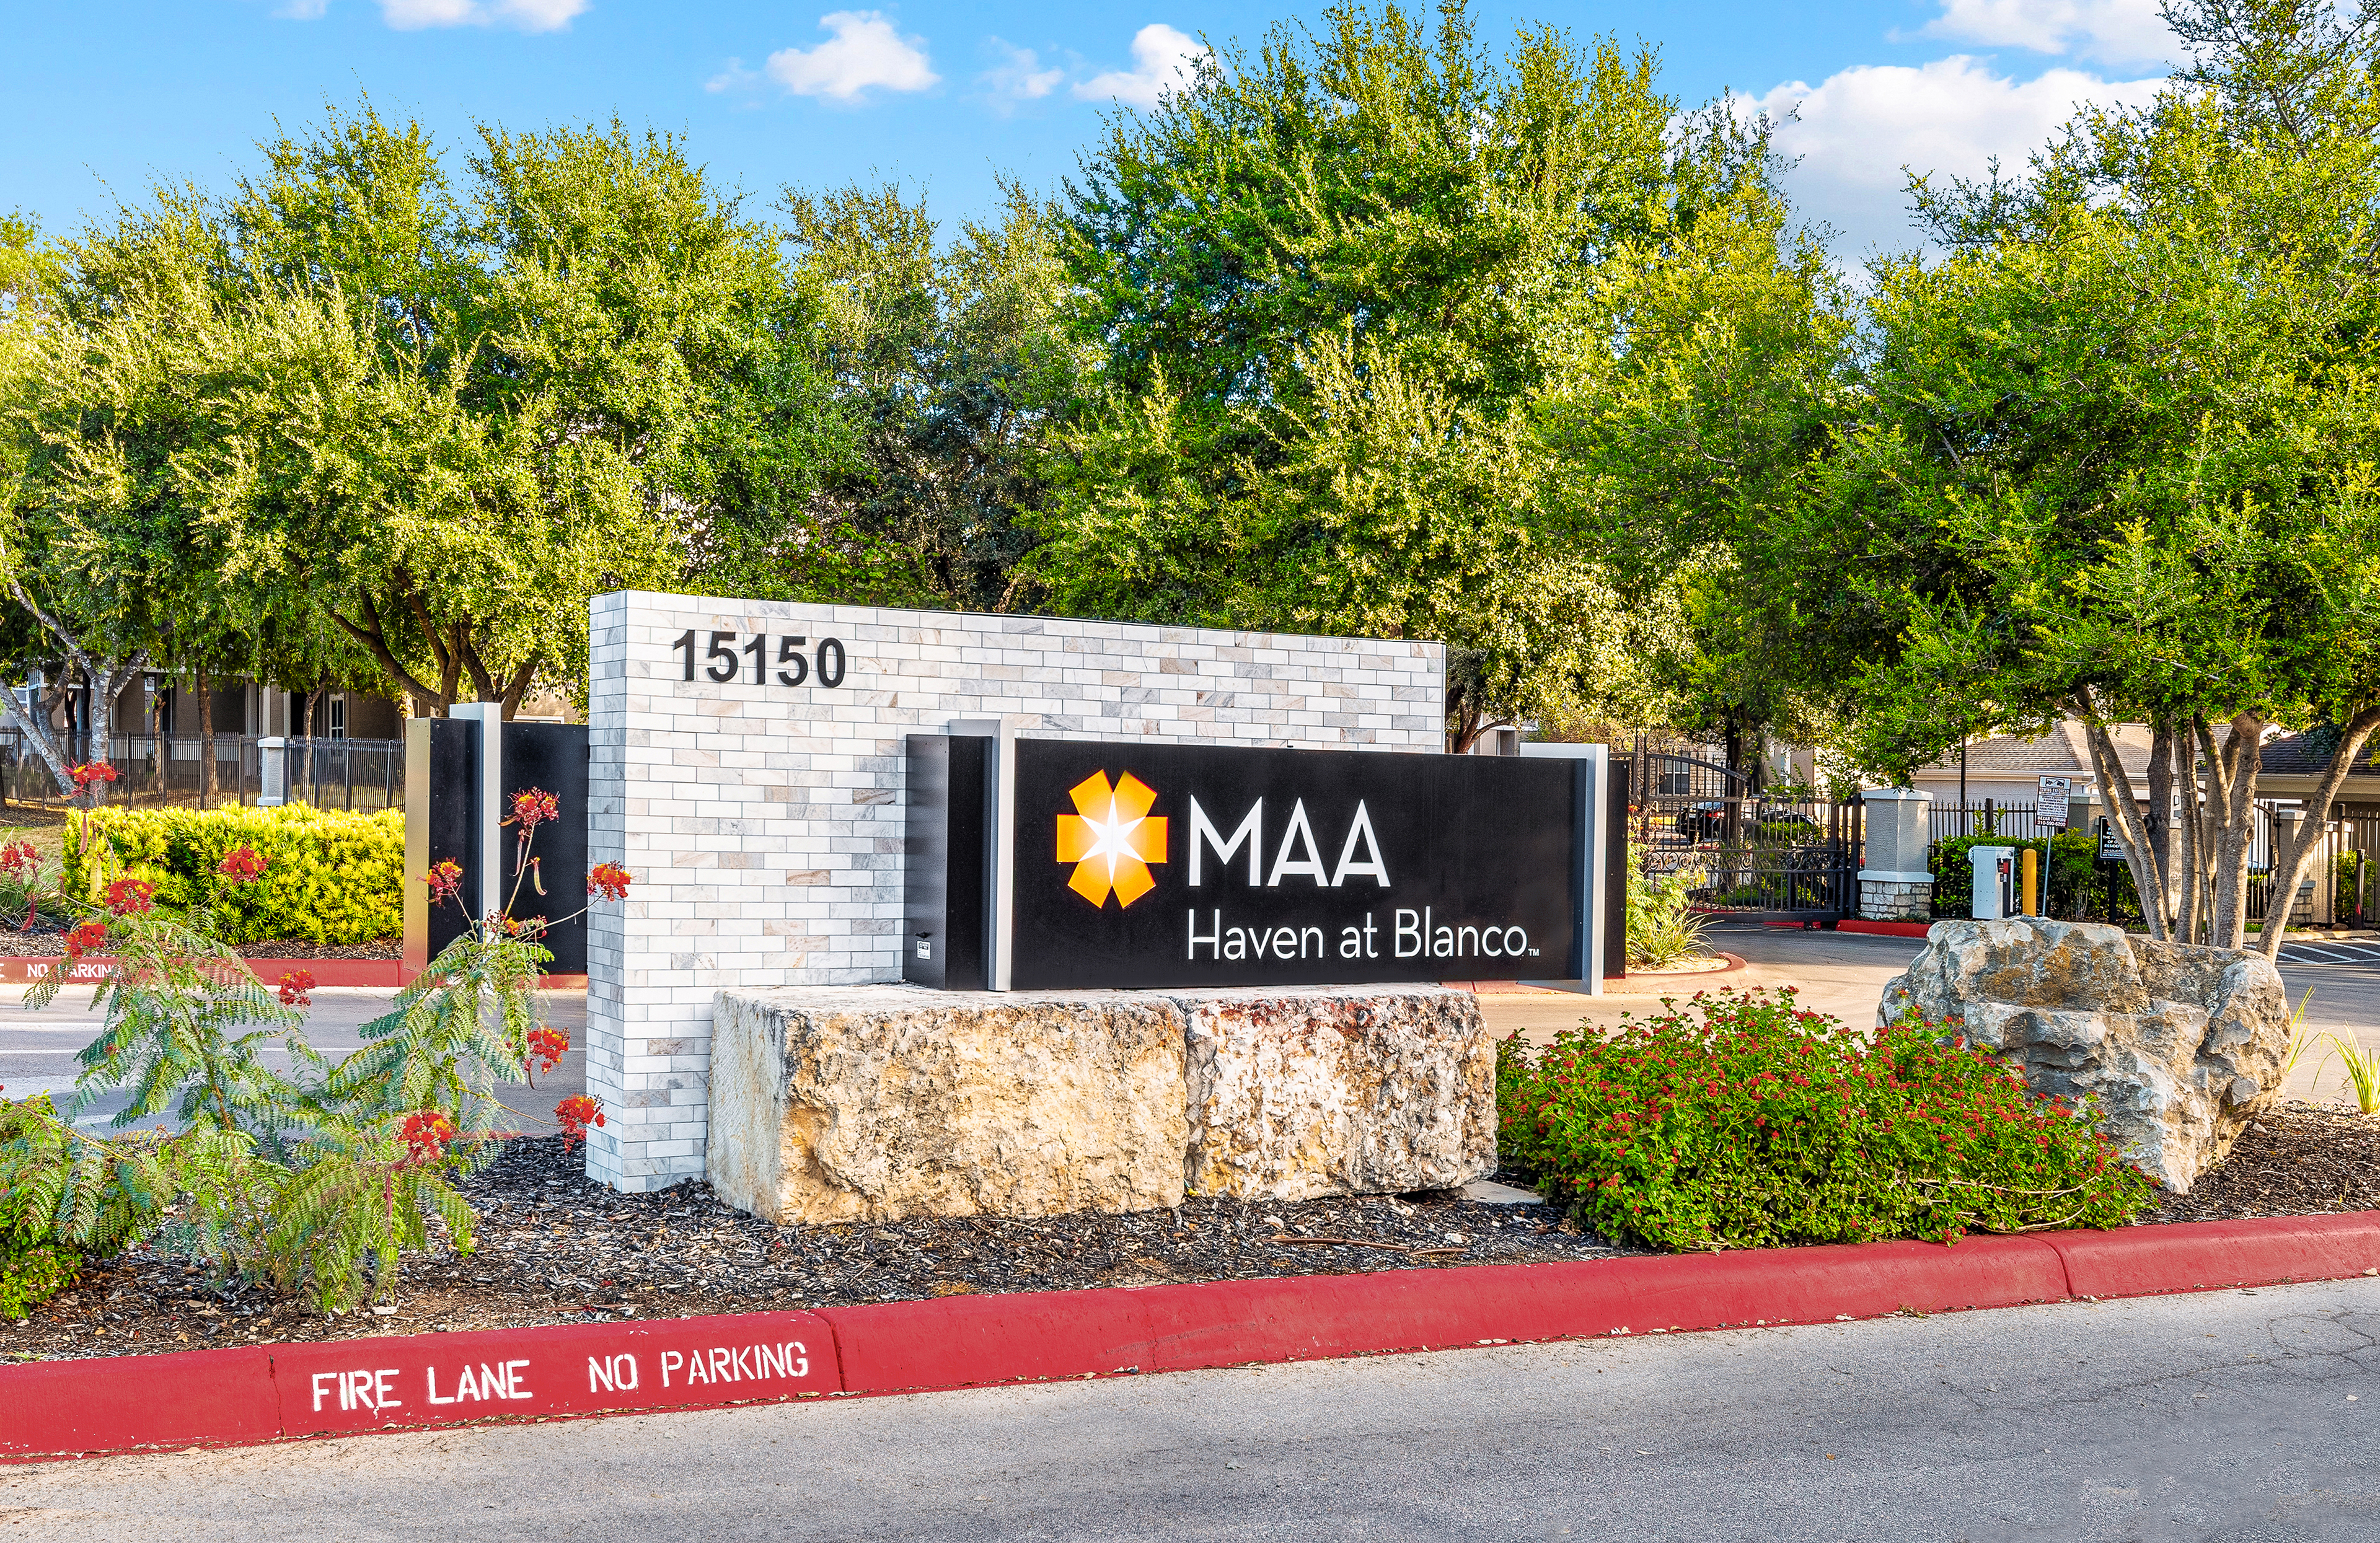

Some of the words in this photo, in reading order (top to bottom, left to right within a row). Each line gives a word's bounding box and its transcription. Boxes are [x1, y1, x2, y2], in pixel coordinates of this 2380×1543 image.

[673, 629, 845, 688] 15150
[1189, 794, 1391, 887] MAA
[1188, 908, 1323, 960] Haven
[1339, 912, 1378, 959] at
[27, 963, 50, 978] NO
[312, 1368, 402, 1412] FIRE
[426, 1359, 534, 1405] LANE
[588, 1353, 639, 1393] NO
[661, 1342, 809, 1387] PARKING
